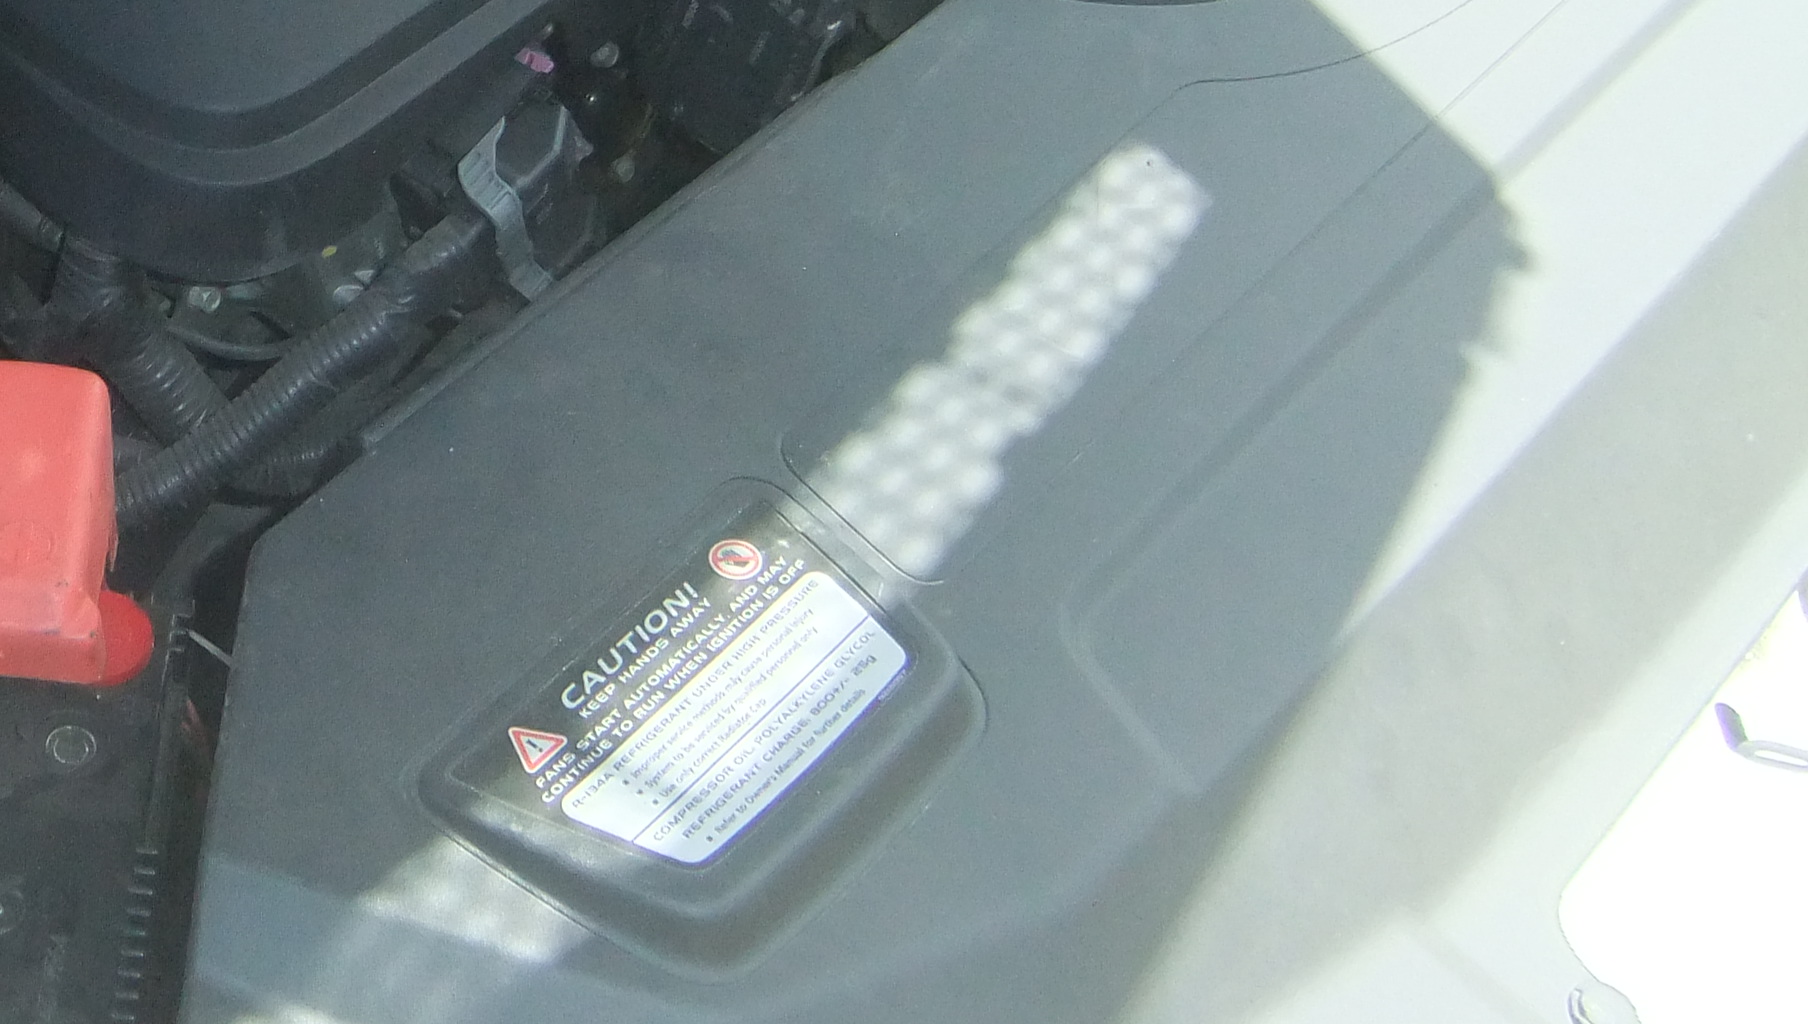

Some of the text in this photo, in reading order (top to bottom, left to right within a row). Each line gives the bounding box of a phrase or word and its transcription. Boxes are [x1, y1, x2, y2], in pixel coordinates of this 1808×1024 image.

[531, 555, 789, 789] FANS START AUTOMATICALLY, AND MAY
[537, 556, 808, 804] CONTINUE TO RUN WHEN IGNITION IS OFF
[560, 580, 703, 711] CAUTION!
[575, 596, 714, 719] KEEP HANDS AWAY
[609, 696, 694, 772] REFRIGERANT
[689, 659, 734, 699] UNDER
[730, 633, 761, 661] HIGH
[757, 578, 820, 635] PRESSURE
[650, 764, 735, 842] COMPRESSOR
[752, 667, 835, 746] POLYALKYLENE
[831, 627, 876, 669] GLYCOL
[680, 761, 763, 839] REFRIGERANT
